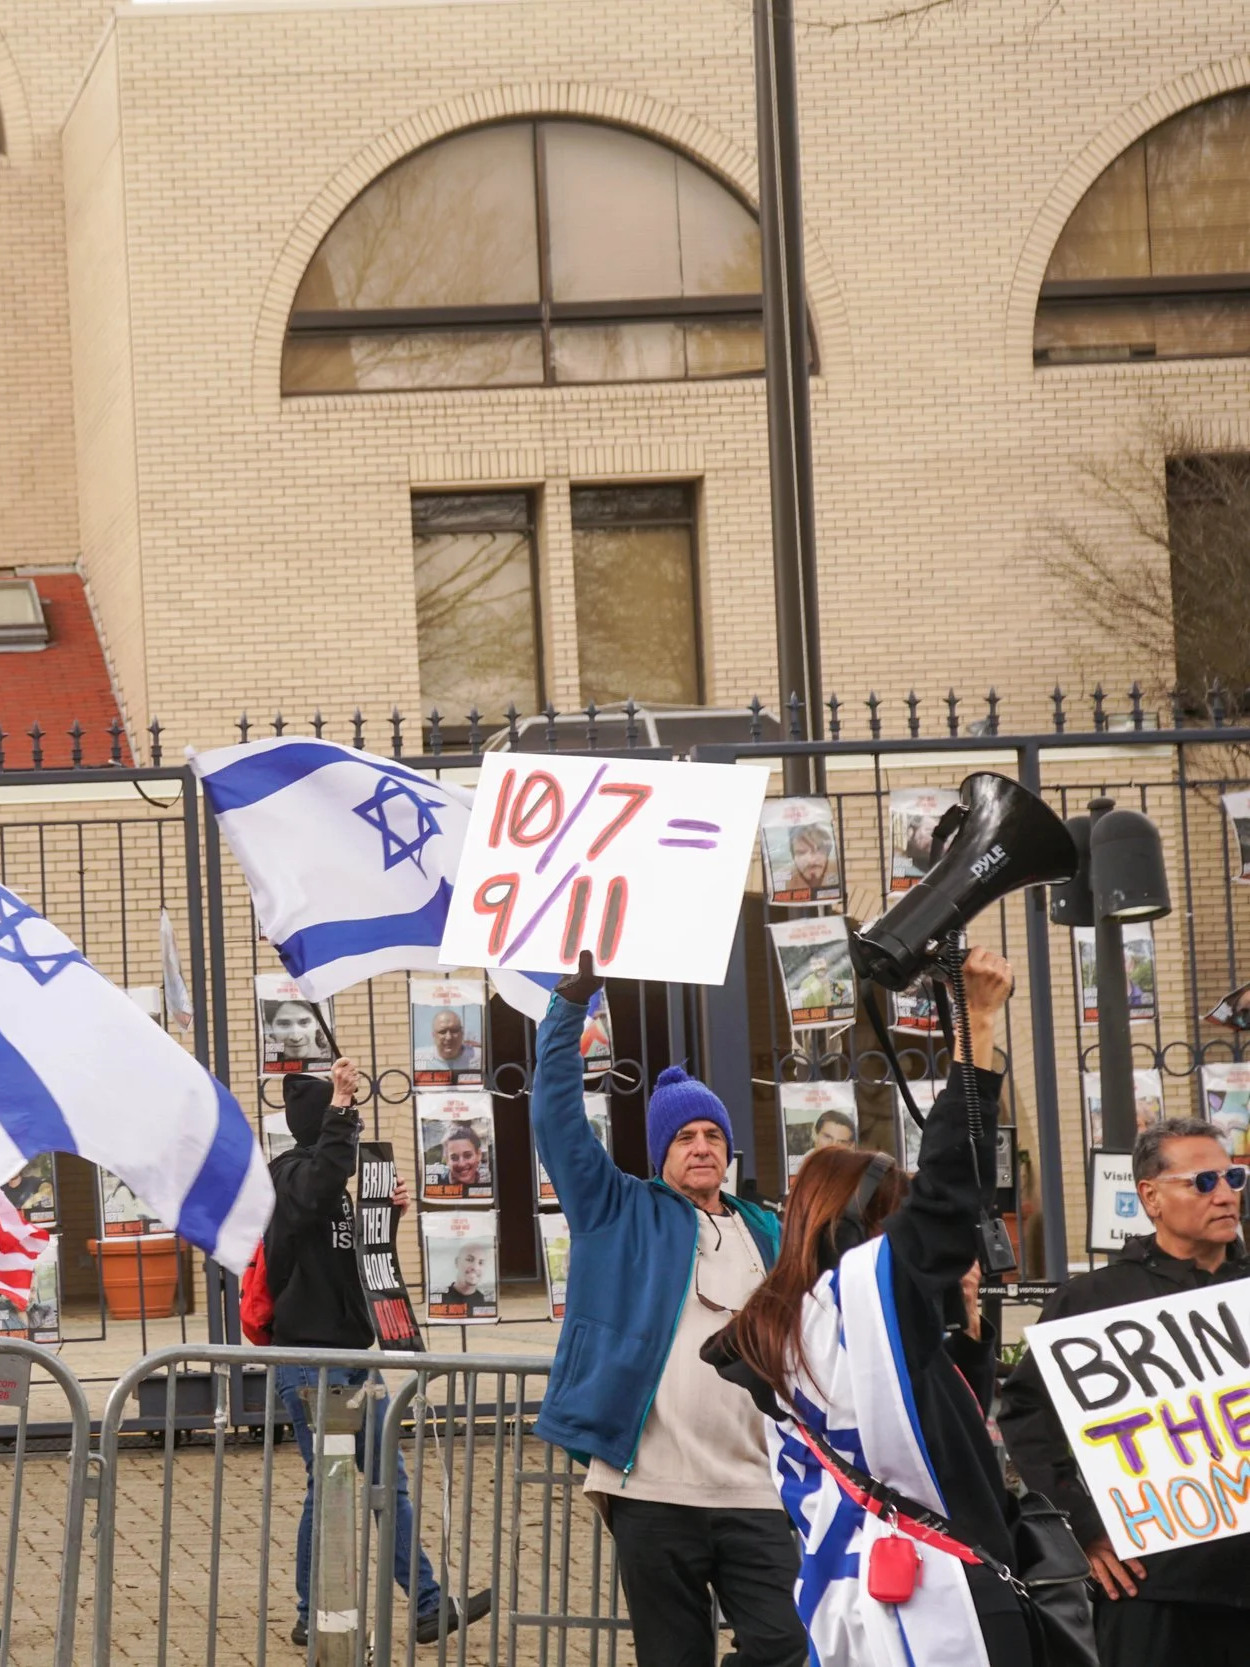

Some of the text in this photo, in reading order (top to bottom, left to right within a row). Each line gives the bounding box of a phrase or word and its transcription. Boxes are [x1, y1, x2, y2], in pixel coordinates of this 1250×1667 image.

[488, 762, 654, 875] 10/7
[970, 844, 1007, 879] PYLE
[473, 862, 629, 967] 9/11
[362, 1161, 397, 1199] BRING
[1103, 1171, 1135, 1182] Visit
[362, 1207, 392, 1245] THEM
[363, 1252, 400, 1291] HOME
[374, 1298, 415, 1341] NOW!
[1049, 1301, 1250, 1412] BRIN
[1080, 1381, 1250, 1478] THE
[1109, 1456, 1250, 1551] HOM
